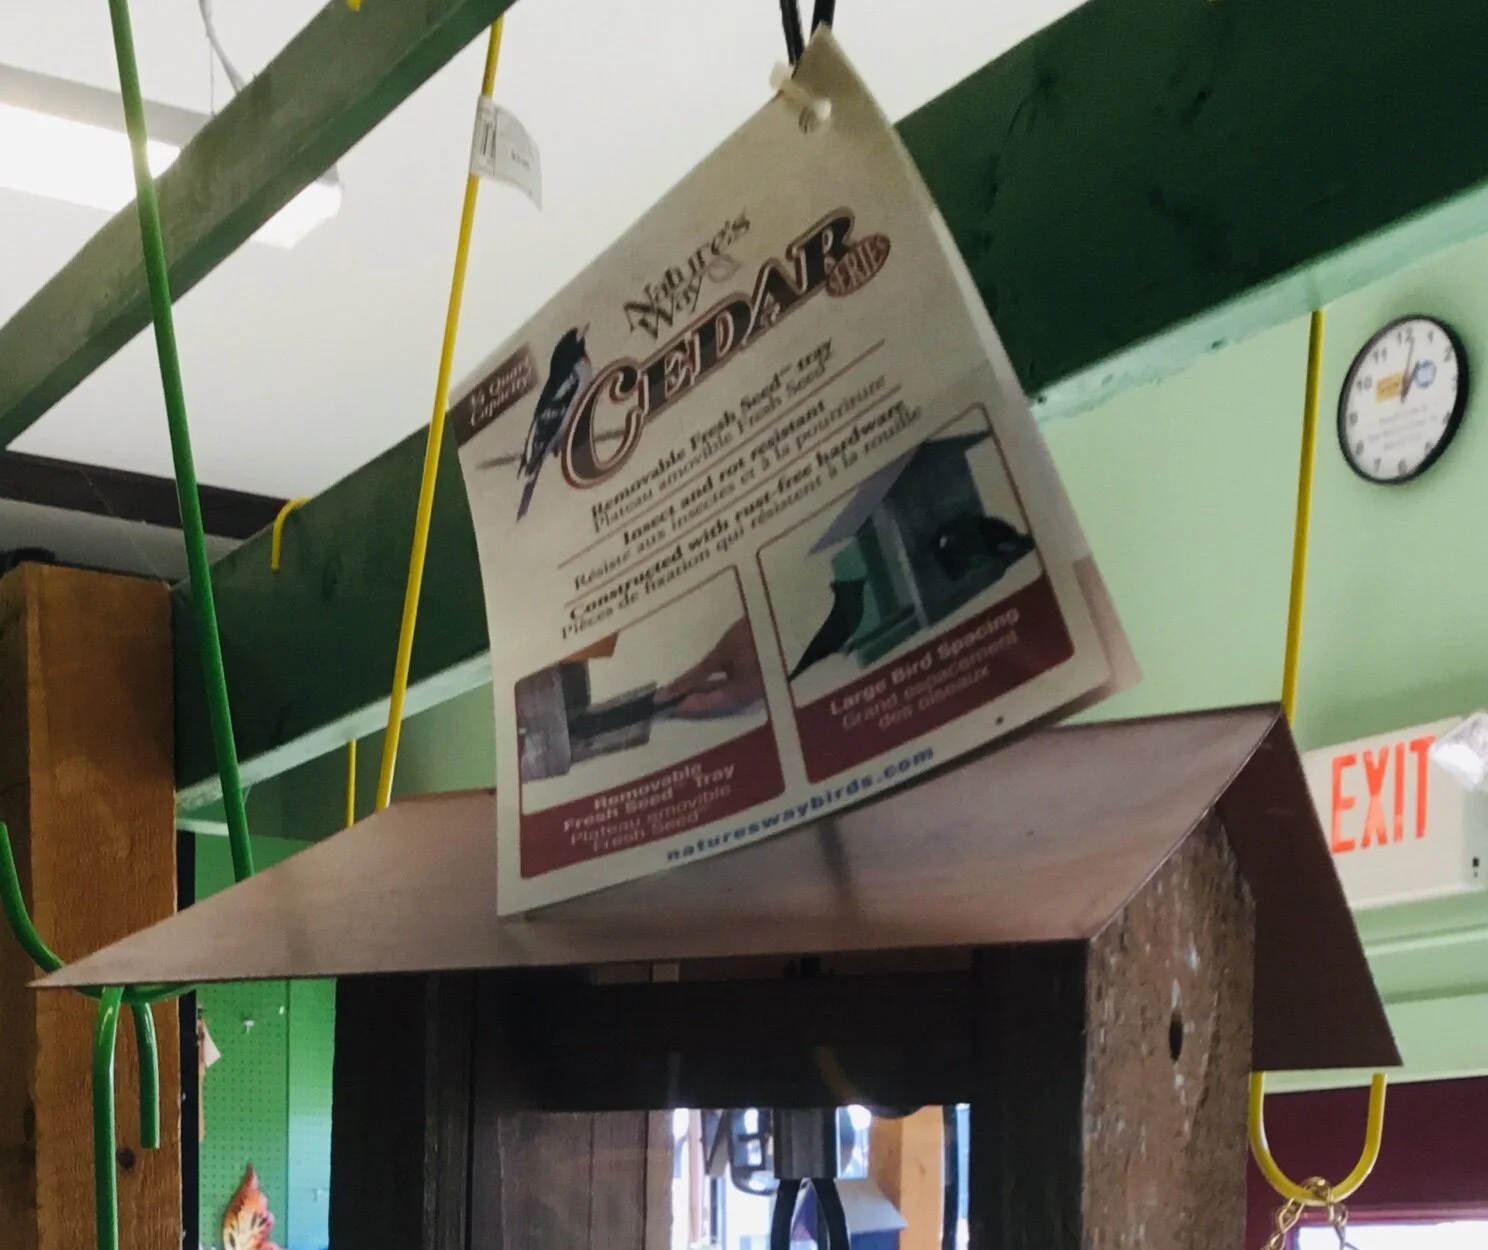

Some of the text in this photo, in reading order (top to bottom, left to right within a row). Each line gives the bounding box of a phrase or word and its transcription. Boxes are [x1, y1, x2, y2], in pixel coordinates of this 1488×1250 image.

[623, 205, 750, 333] Nature's
[561, 205, 856, 490] CEDAR
[592, 449, 686, 519] Removable
[689, 410, 736, 451] Fresh
[797, 338, 833, 371] tray
[623, 399, 825, 546] Insect and rot resistant
[570, 399, 905, 620] Constructed with rust-free hardware
[594, 487, 653, 533] Plateau
[618, 590, 640, 610] de
[715, 526, 745, 552] qui
[829, 607, 1020, 716] Large Bird Spacing
[841, 692, 898, 731] Grand
[877, 704, 914, 731] des
[563, 806, 619, 833] Fresh
[695, 763, 735, 788] Tray
[571, 784, 732, 846] Plateau amovible
[594, 762, 703, 810] Removable
[666, 746, 935, 862] natureswaybirds.com
[1331, 736, 1437, 856] EXIT
